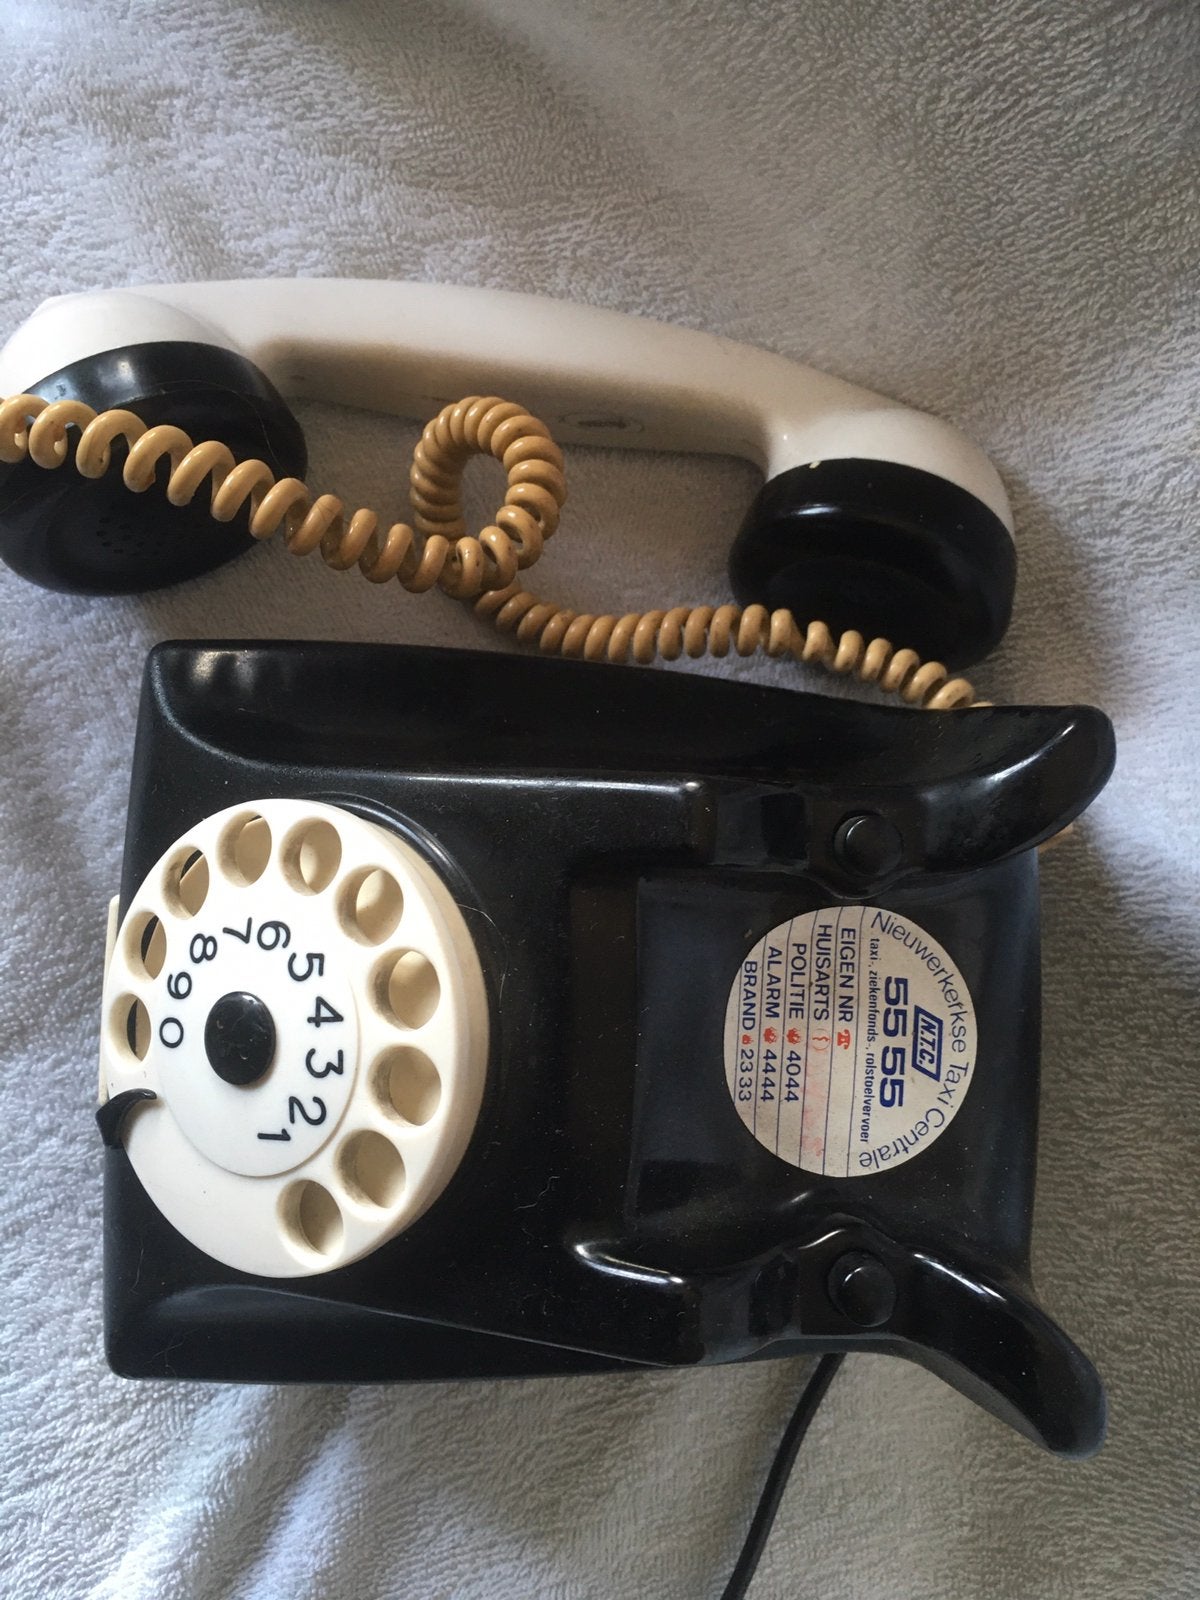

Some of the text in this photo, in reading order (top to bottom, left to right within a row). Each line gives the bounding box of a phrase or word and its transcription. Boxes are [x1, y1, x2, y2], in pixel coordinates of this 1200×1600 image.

[222, 917, 253, 944] 7
[257, 920, 291, 951] 6
[190, 933, 218, 964] 8
[288, 952, 325, 982] 5
[765, 946, 783, 1018] ALARM
[813, 924, 833, 1021] HUISARTS
[838, 927, 856, 1023] EIGEN NR
[167, 972, 193, 1000] 9
[742, 961, 758, 1030] BRAND
[307, 996, 344, 1027] 4
[784, 943, 807, 1102] POLITIE 4044
[159, 1017, 184, 1048] 0
[859, 911, 970, 1169] Nieuwerkerkse Taxi Centrale
[879, 976, 908, 1108] 55 55
[306, 1049, 344, 1079] 3
[288, 1096, 327, 1125] 2
[860, 1052, 875, 1143] rolstoelvervoer
[257, 1128, 291, 1143] 1
